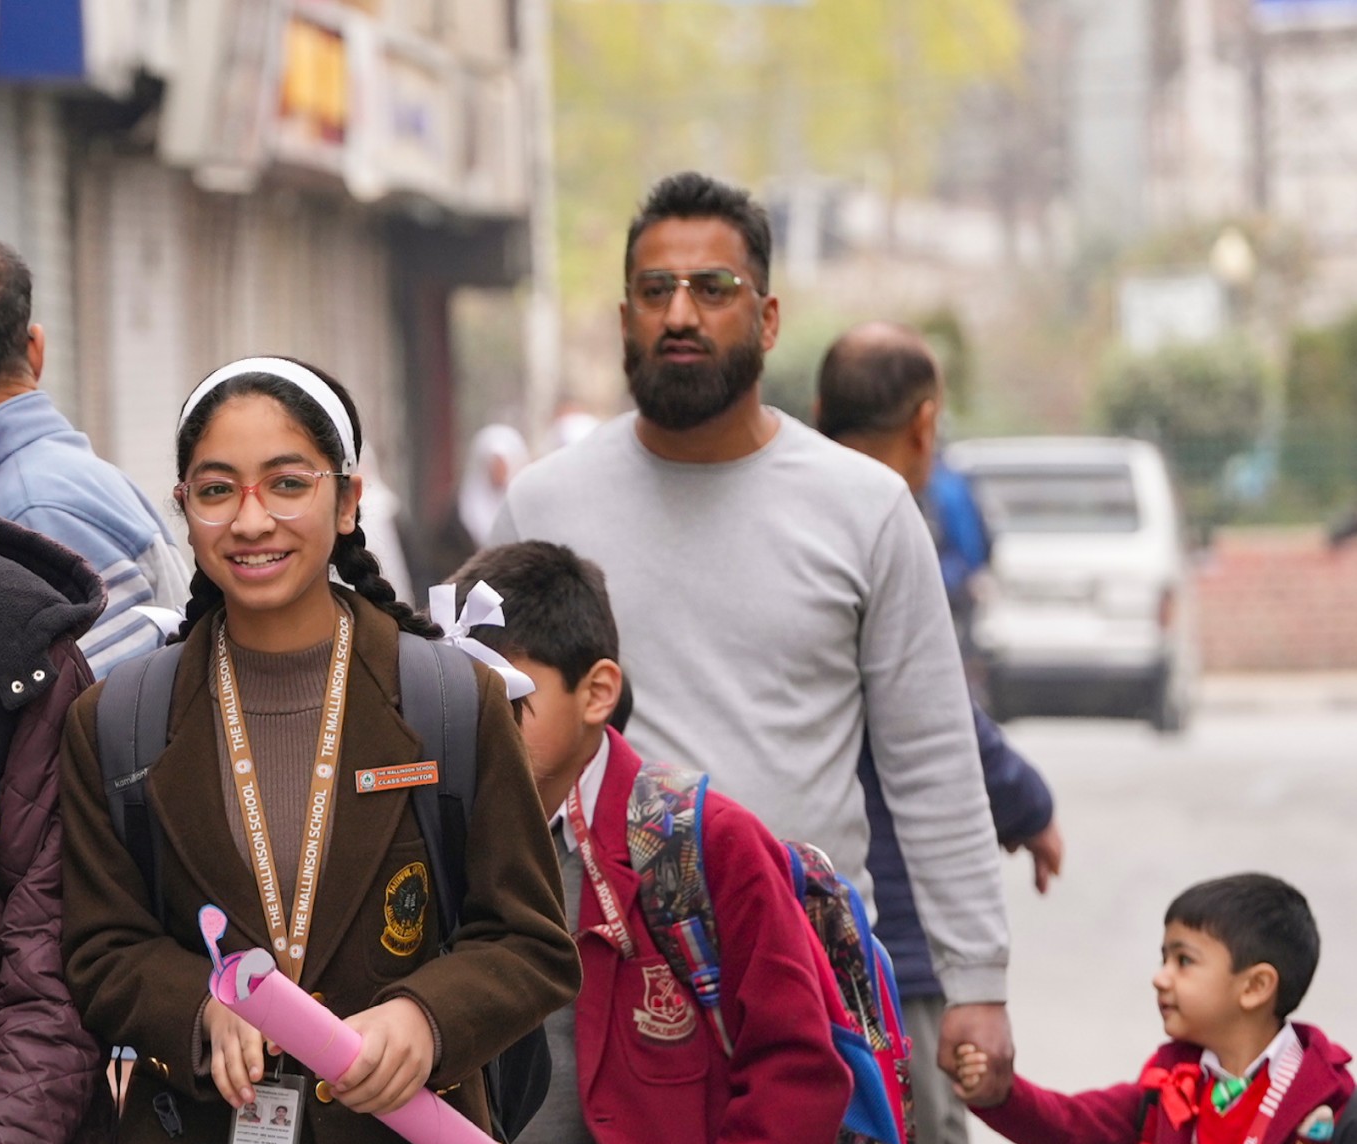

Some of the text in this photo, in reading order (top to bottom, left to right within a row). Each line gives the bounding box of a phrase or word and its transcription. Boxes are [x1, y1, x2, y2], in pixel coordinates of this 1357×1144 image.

[218, 656, 245, 726] MALLINSON
[320, 615, 348, 757] THE MALLINSON SCHOOL
[233, 726, 248, 752] THE
[378, 774, 433, 786] CLASS MONITOR
[387, 767, 415, 775] MALLINSON
[241, 780, 282, 929] THE MALLINSON SCHOOL
[293, 789, 327, 938] THE MALLINSON SCHOOL
[580, 839, 602, 882] SCHOOL
[596, 882, 619, 924] BISCOE
